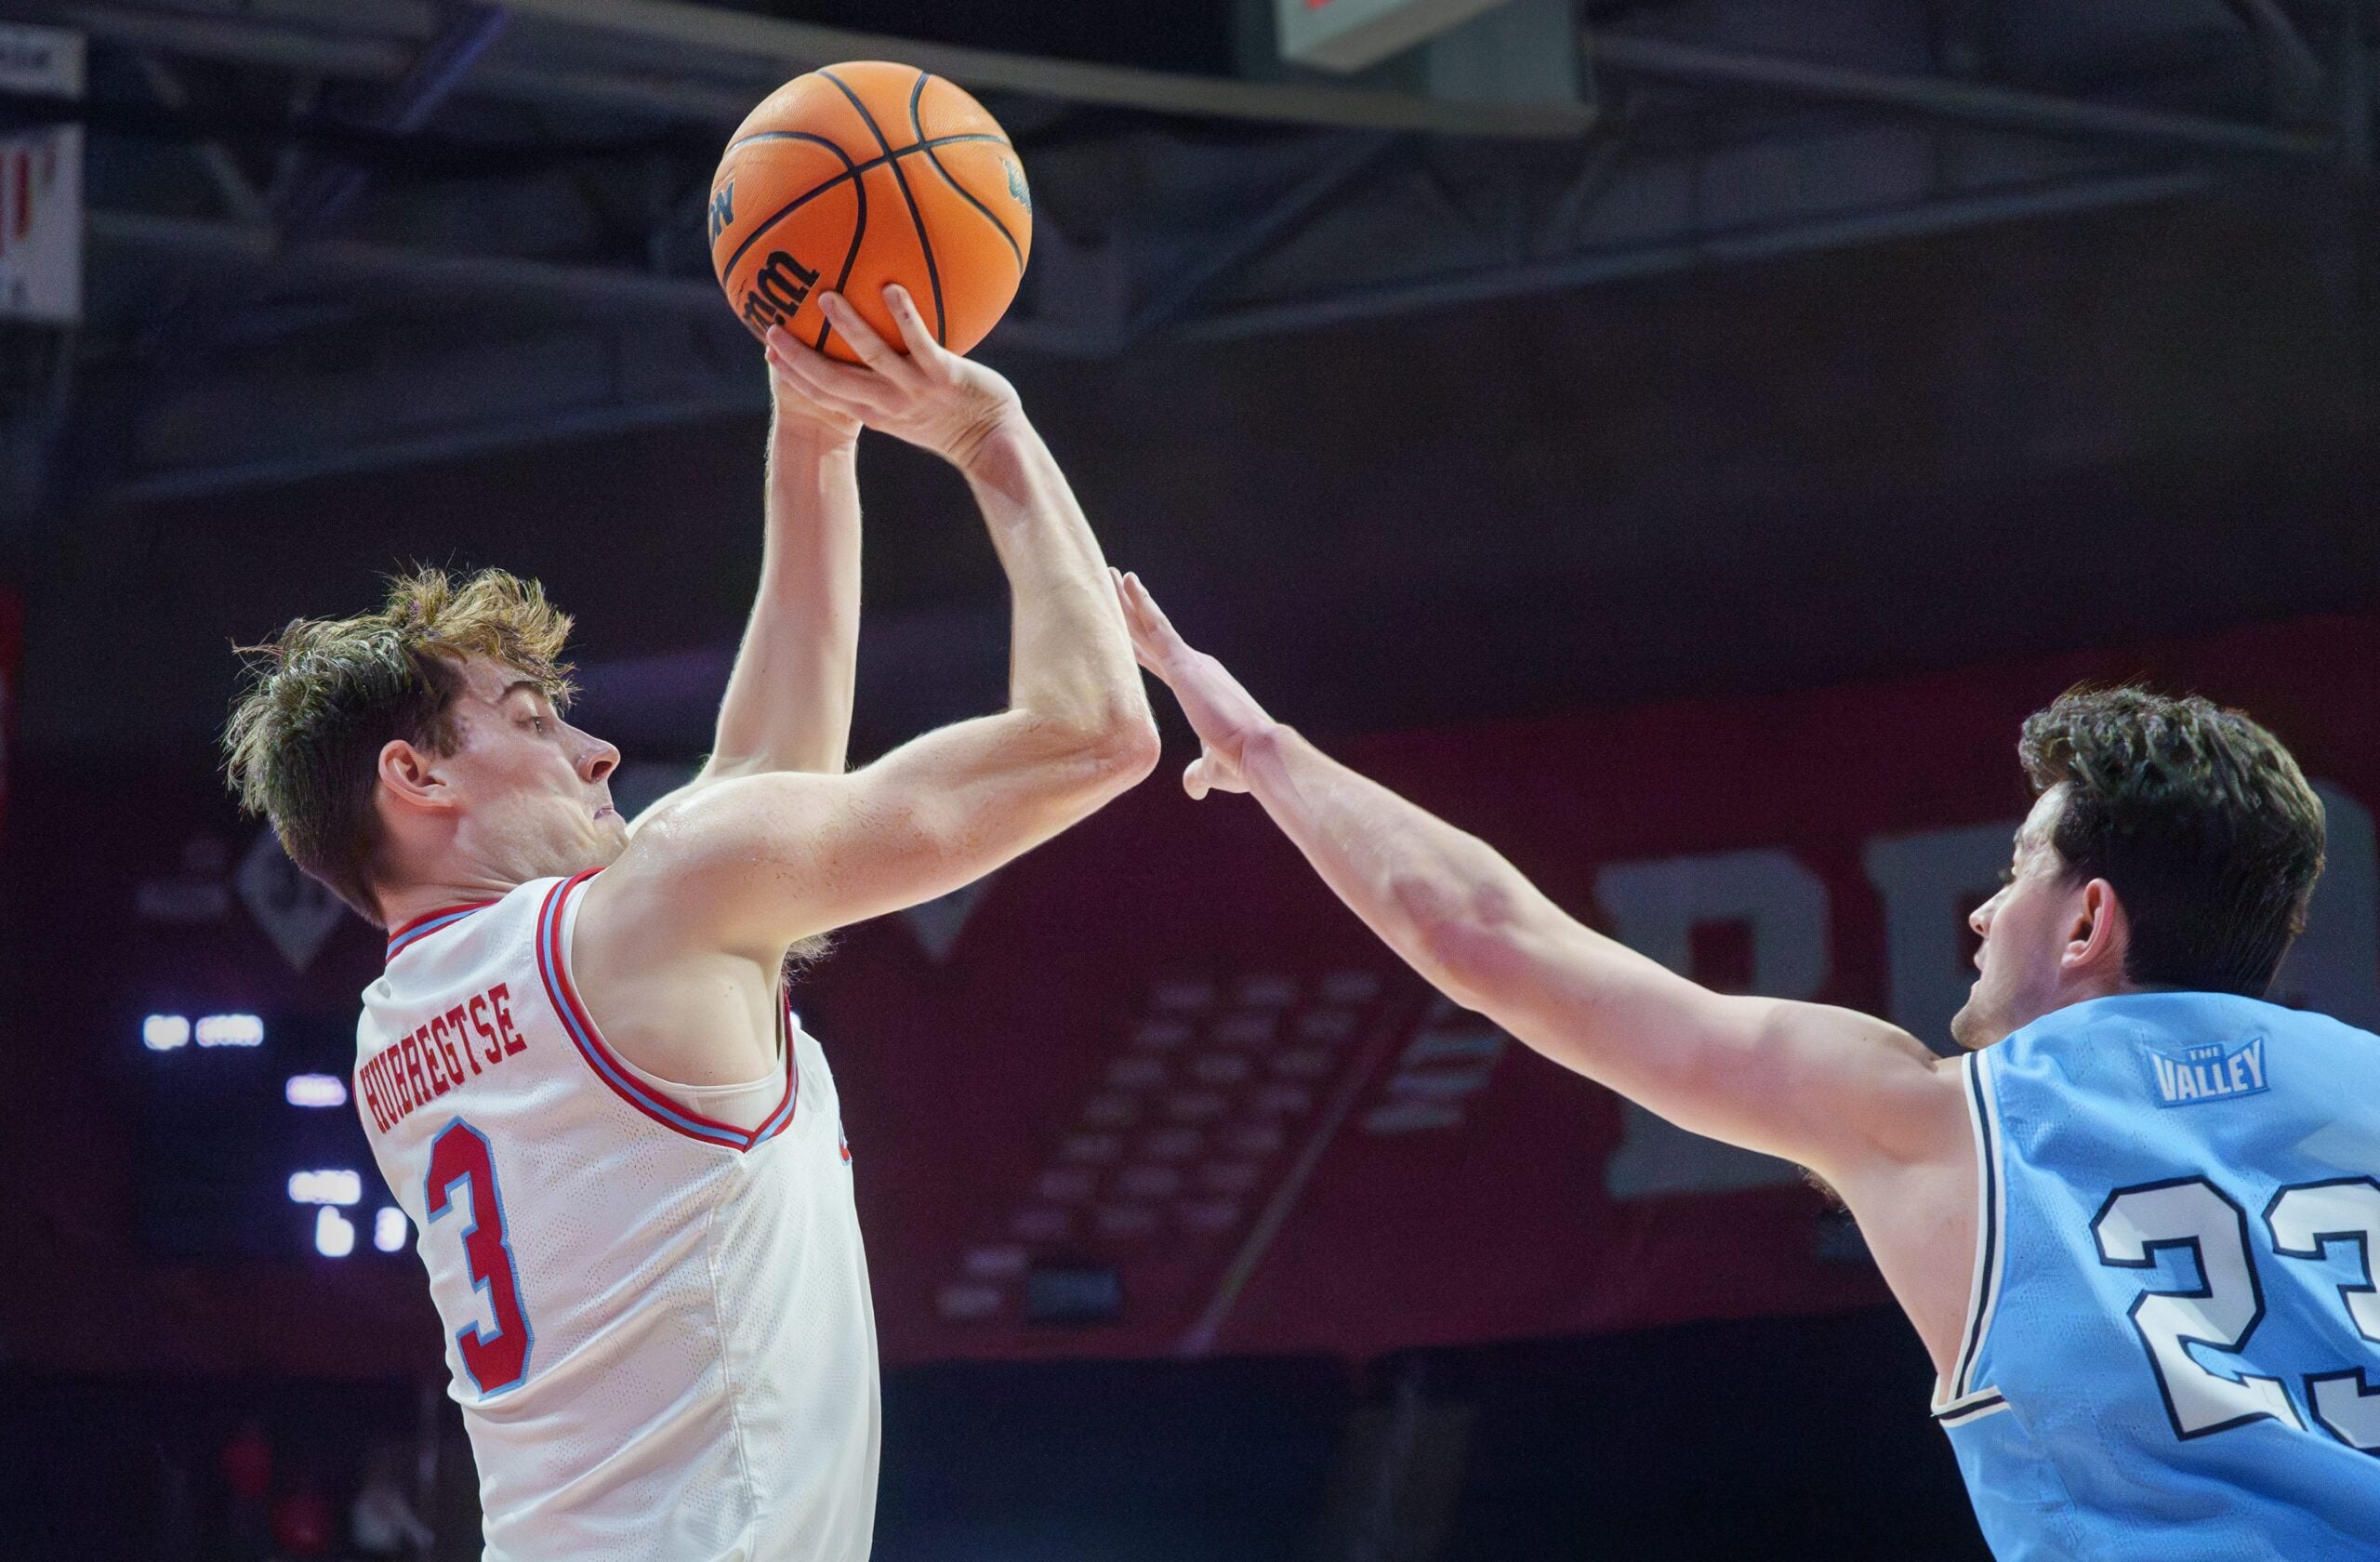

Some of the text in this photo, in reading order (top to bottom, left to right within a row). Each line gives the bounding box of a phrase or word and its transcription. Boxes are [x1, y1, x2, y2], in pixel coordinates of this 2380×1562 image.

[359, 982, 528, 1134] HUIBREGTSE
[2151, 1039, 2265, 1102] VALLEY
[424, 1115, 536, 1402] 3
[2088, 1173, 2380, 1460] 23
